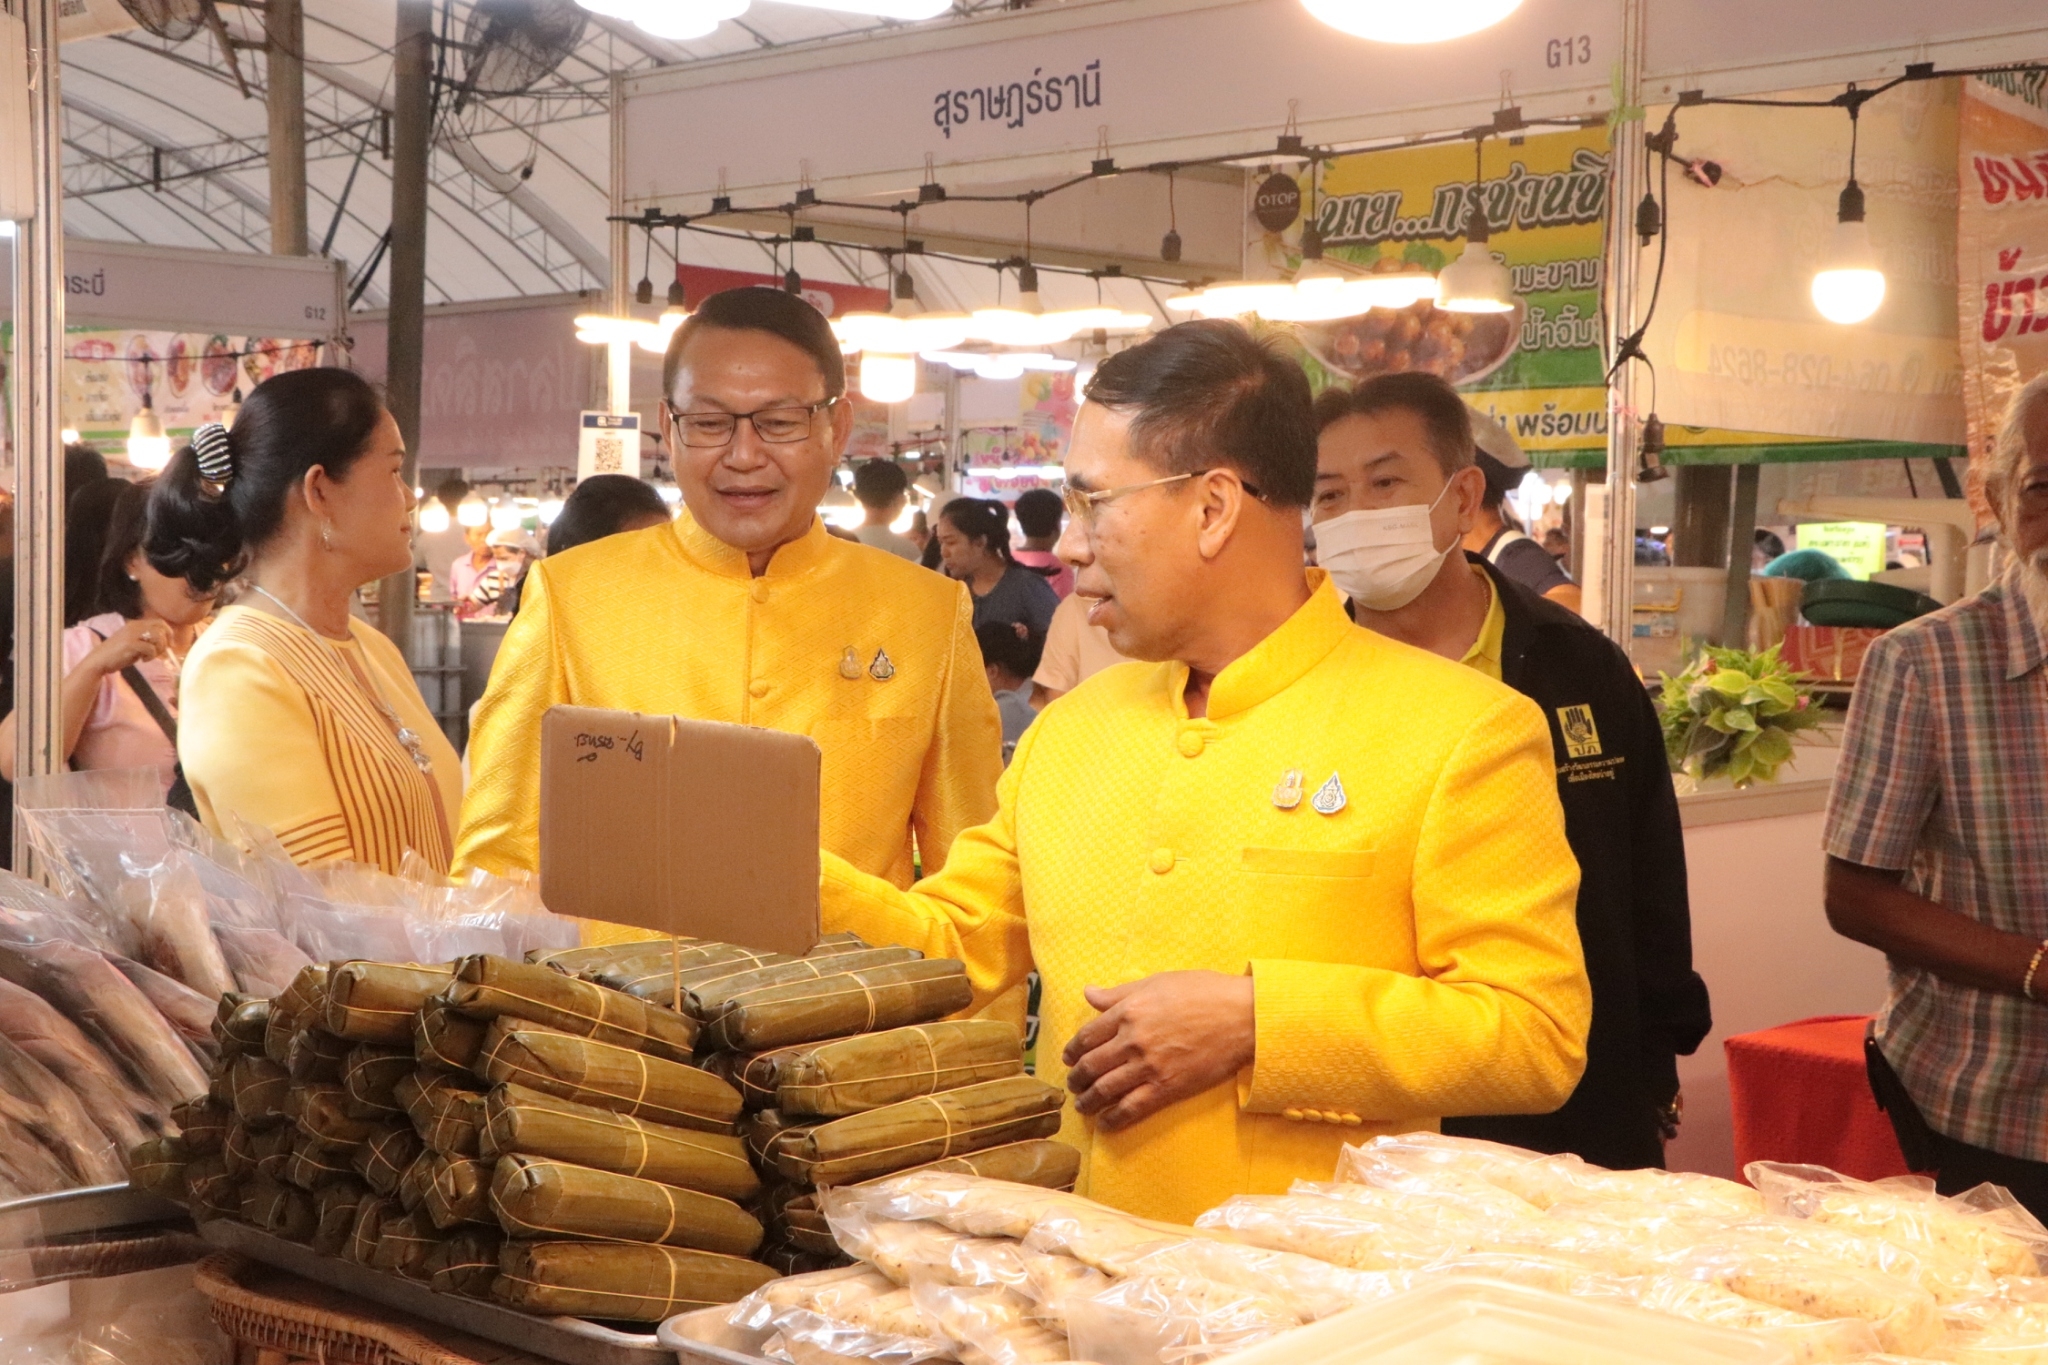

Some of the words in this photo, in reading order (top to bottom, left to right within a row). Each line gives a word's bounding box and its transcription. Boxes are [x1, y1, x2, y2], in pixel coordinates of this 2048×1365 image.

[1546, 34, 1591, 69] G13
[1258, 190, 1298, 207] OTOP
[304, 305, 326, 320] G12
